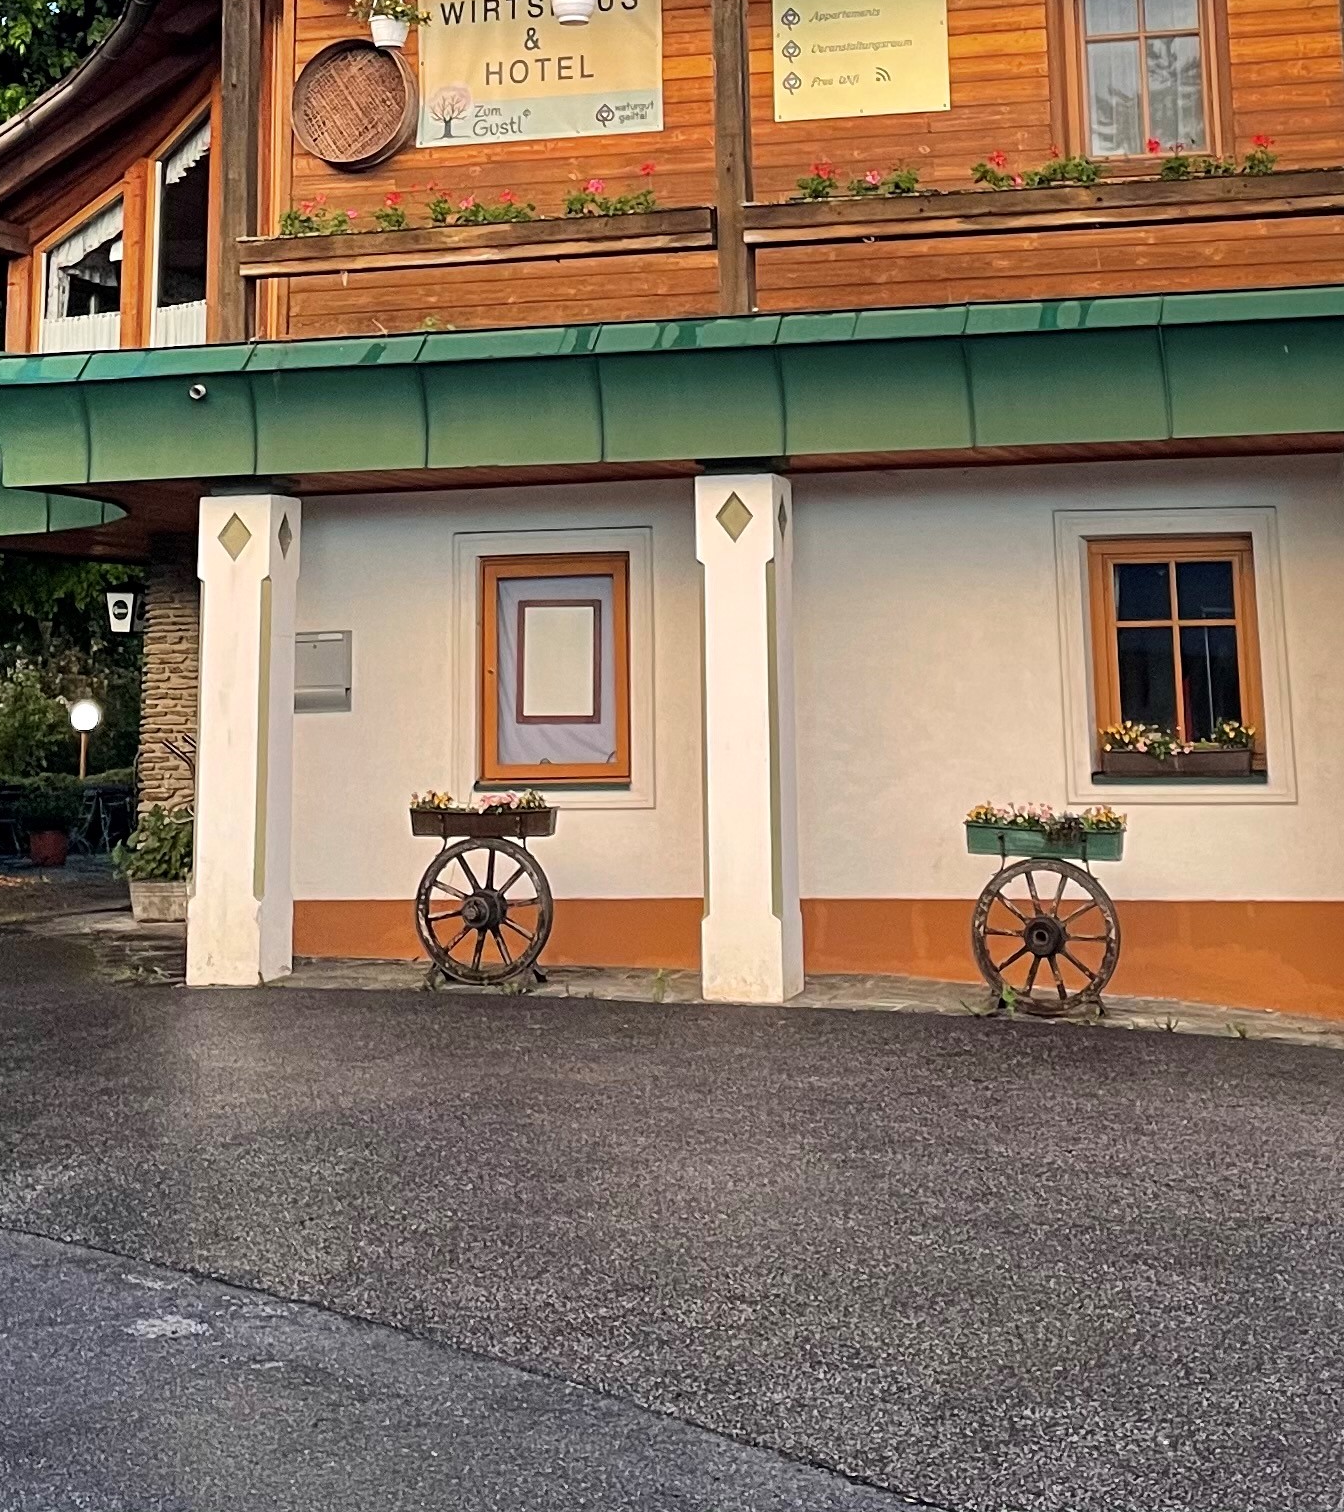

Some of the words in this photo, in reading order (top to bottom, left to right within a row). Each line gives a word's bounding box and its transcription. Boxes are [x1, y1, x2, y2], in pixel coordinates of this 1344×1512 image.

[524, 27, 541, 51] &
[485, 55, 594, 86] HOTEL
[474, 105, 502, 119] Zum
[472, 115, 523, 137] Gustl
